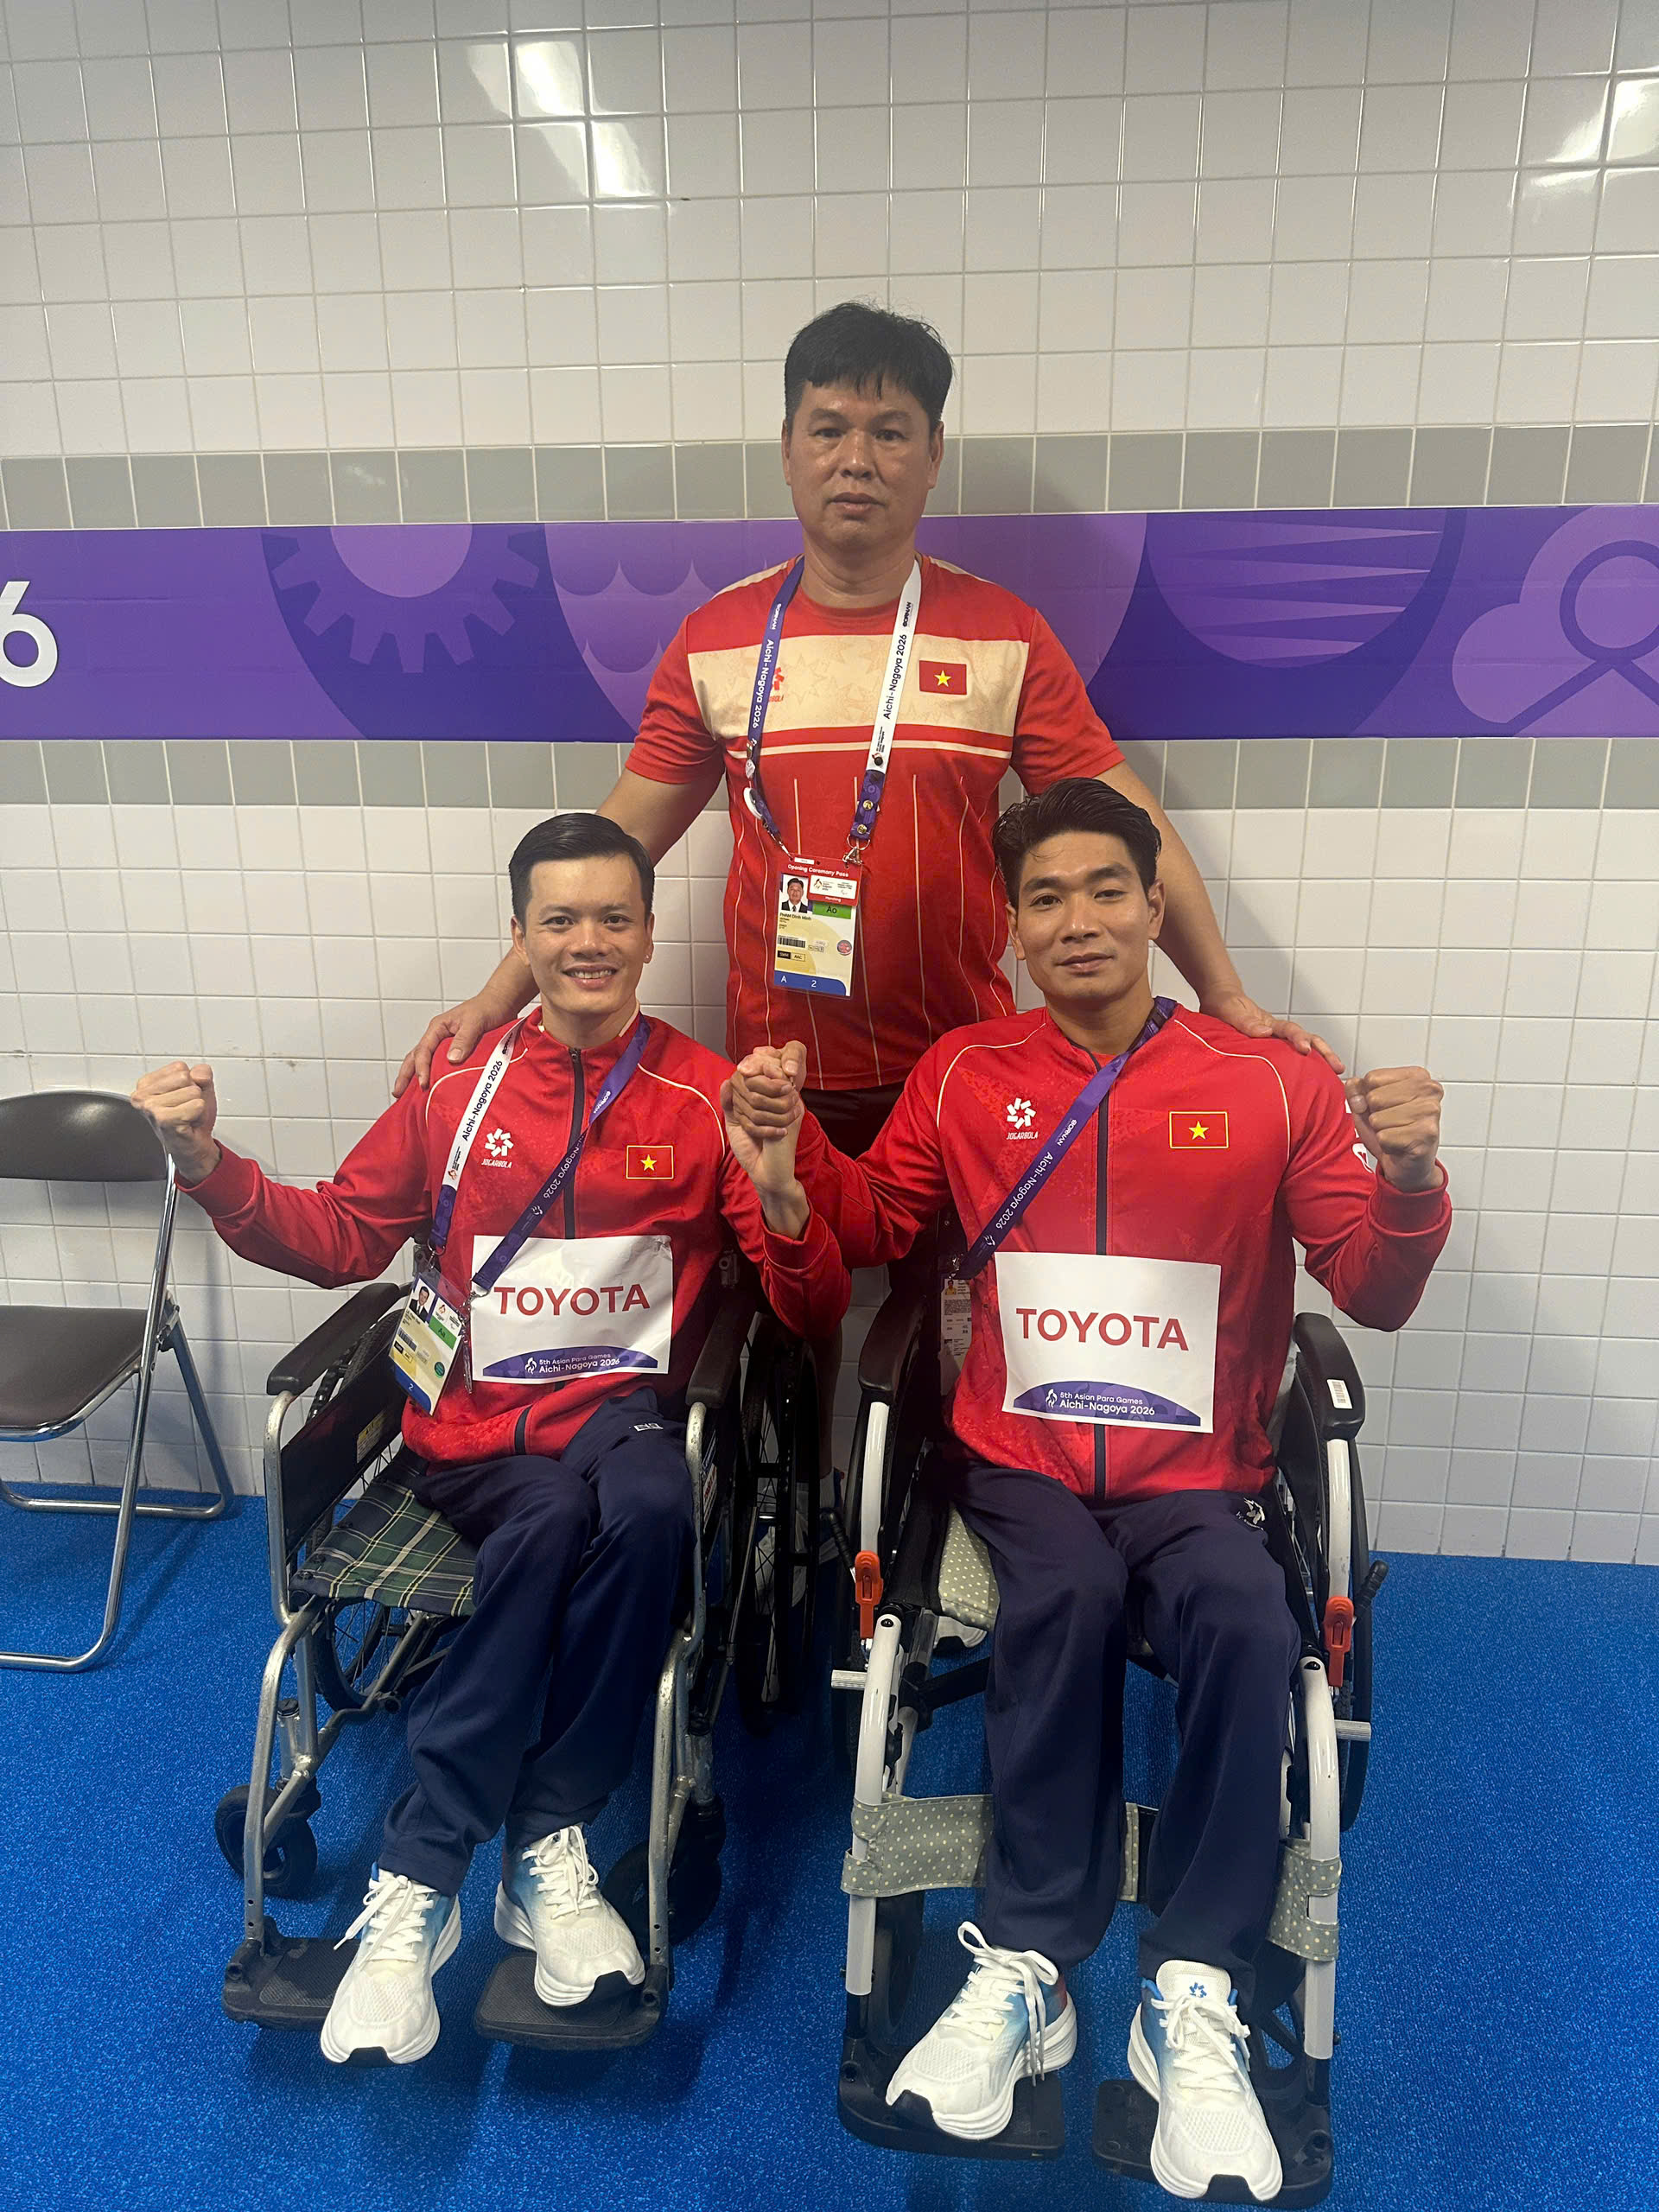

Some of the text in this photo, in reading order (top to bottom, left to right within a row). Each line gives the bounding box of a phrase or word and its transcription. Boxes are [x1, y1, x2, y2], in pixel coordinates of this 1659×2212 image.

[0, 581, 58, 688] 6
[753, 639, 774, 728] Aichi-Nagoya 2026
[883, 634, 907, 720] Aichi-Nagoya 2026
[787, 864, 808, 873] Opening
[808, 867, 836, 876] Ceremony
[826, 906, 837, 914] Ao
[461, 1060, 503, 1141] Aichi-Nagoya 2026
[1057, 1119, 1077, 1147] BORNAN
[543, 1179, 562, 1199] 2026
[995, 1151, 1053, 1230] Aichi-Nagoya 2026
[494, 1283, 650, 1316] TOYOTA
[1015, 1307, 1189, 1351] TOYOTA
[538, 1358, 620, 1373] Aichi-Nagoya 2026
[1059, 1399, 1155, 1415] Aichi-Nagoya 2026
[1116, 1396, 1143, 1405] Games
